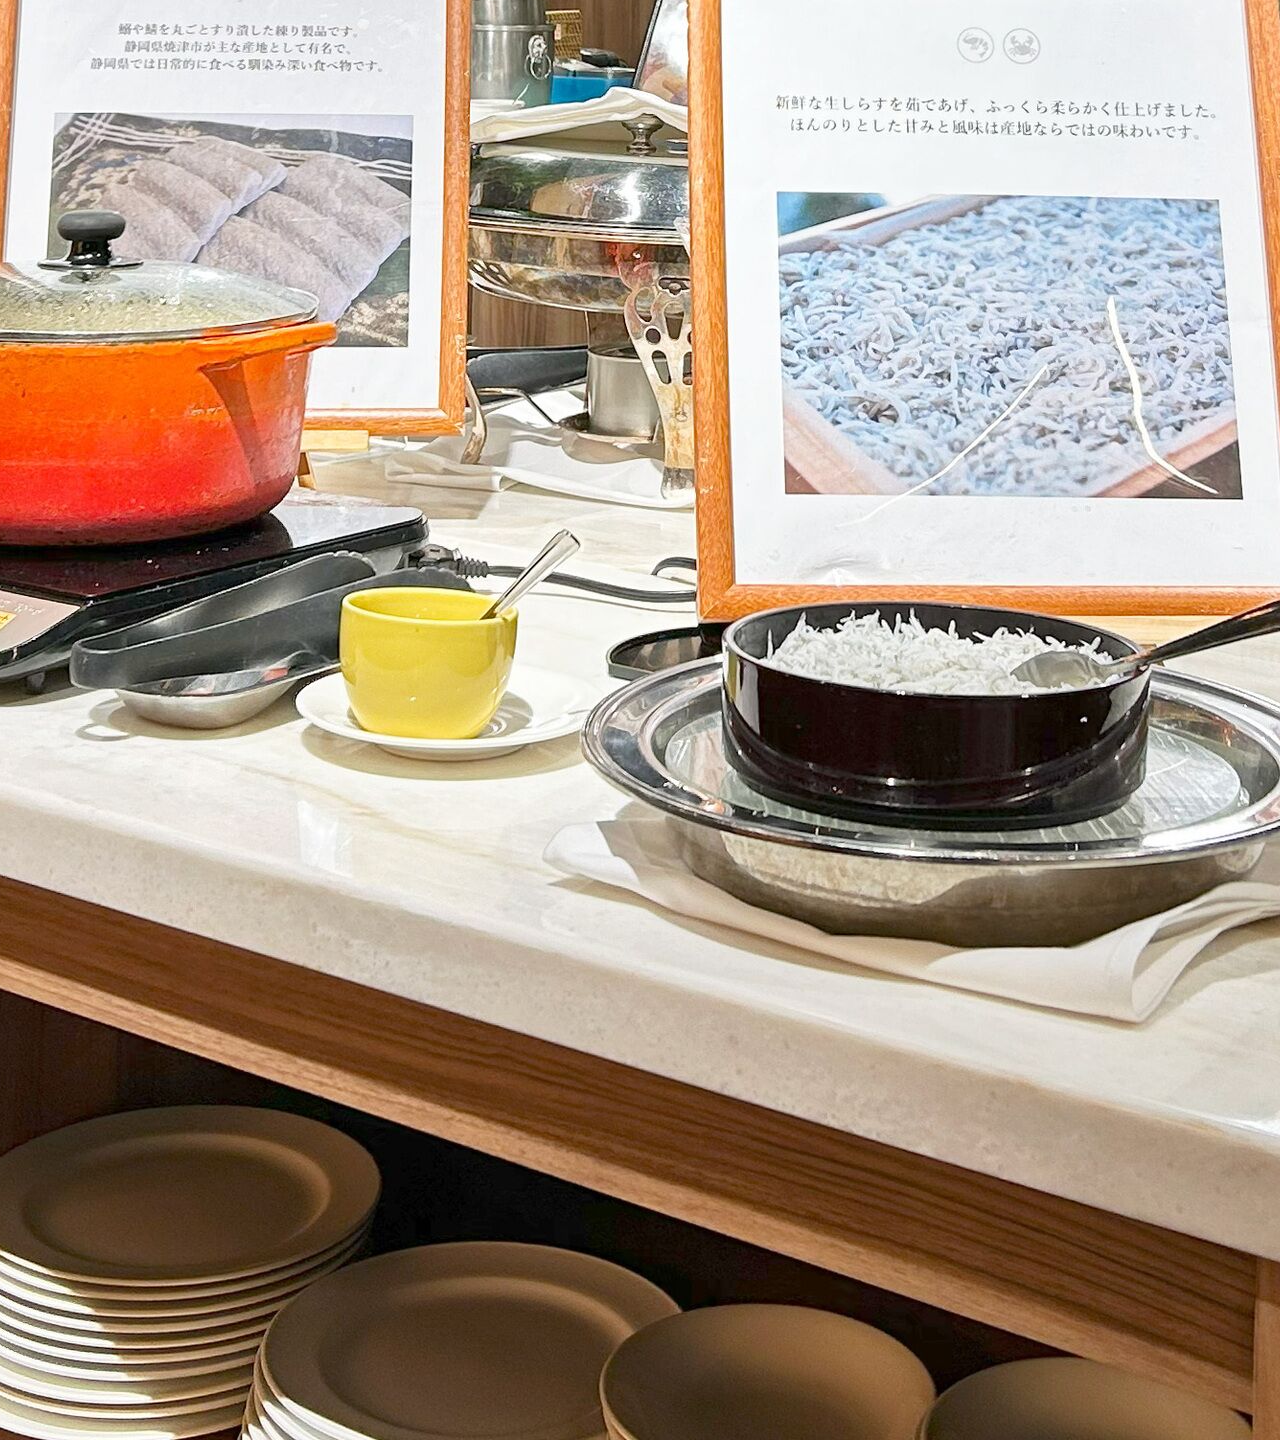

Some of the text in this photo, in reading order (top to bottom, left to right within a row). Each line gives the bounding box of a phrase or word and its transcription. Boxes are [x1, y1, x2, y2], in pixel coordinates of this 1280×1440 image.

[124, 40, 352, 55] 静岡県焼津市が主な産地として有名で、
[90, 57, 383, 72] 静岡県では日常的に食べる馴染み深い食べ物です。
[776, 95, 1216, 119] 新鮮な生しらすを茹であげ、ふっくら柔らかく仕上げました。
[790, 117, 1200, 140] ほんのりとした甘みと風味は産地ならではの味わいです。
